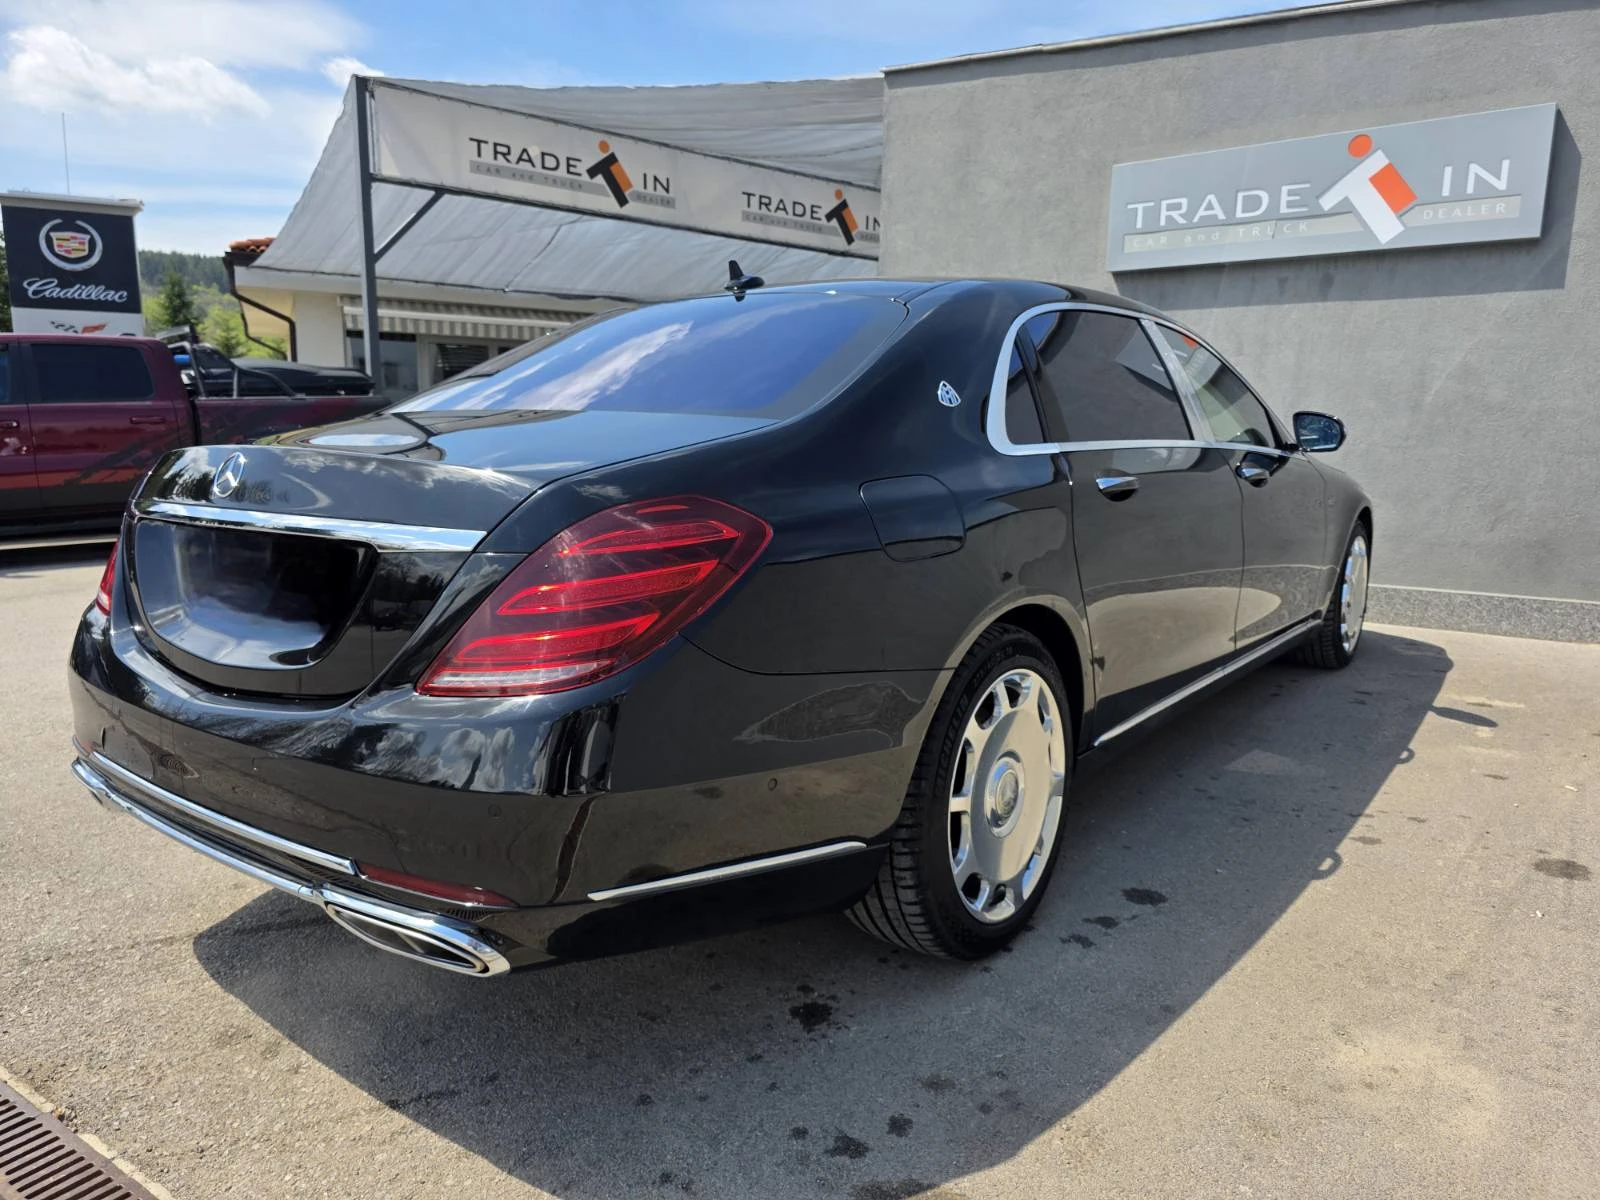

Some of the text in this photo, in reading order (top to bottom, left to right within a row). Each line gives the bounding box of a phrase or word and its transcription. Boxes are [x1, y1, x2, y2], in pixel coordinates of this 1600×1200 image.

[469, 137, 582, 177] TRADE
[643, 172, 670, 194] IN
[742, 191, 822, 221] TRADE
[1127, 183, 1311, 229] TRADE
[1441, 159, 1510, 197] IN
[1423, 202, 1507, 220] DEALER
[1132, 236, 1168, 248] CAR
[23, 277, 128, 303] Cadillac
